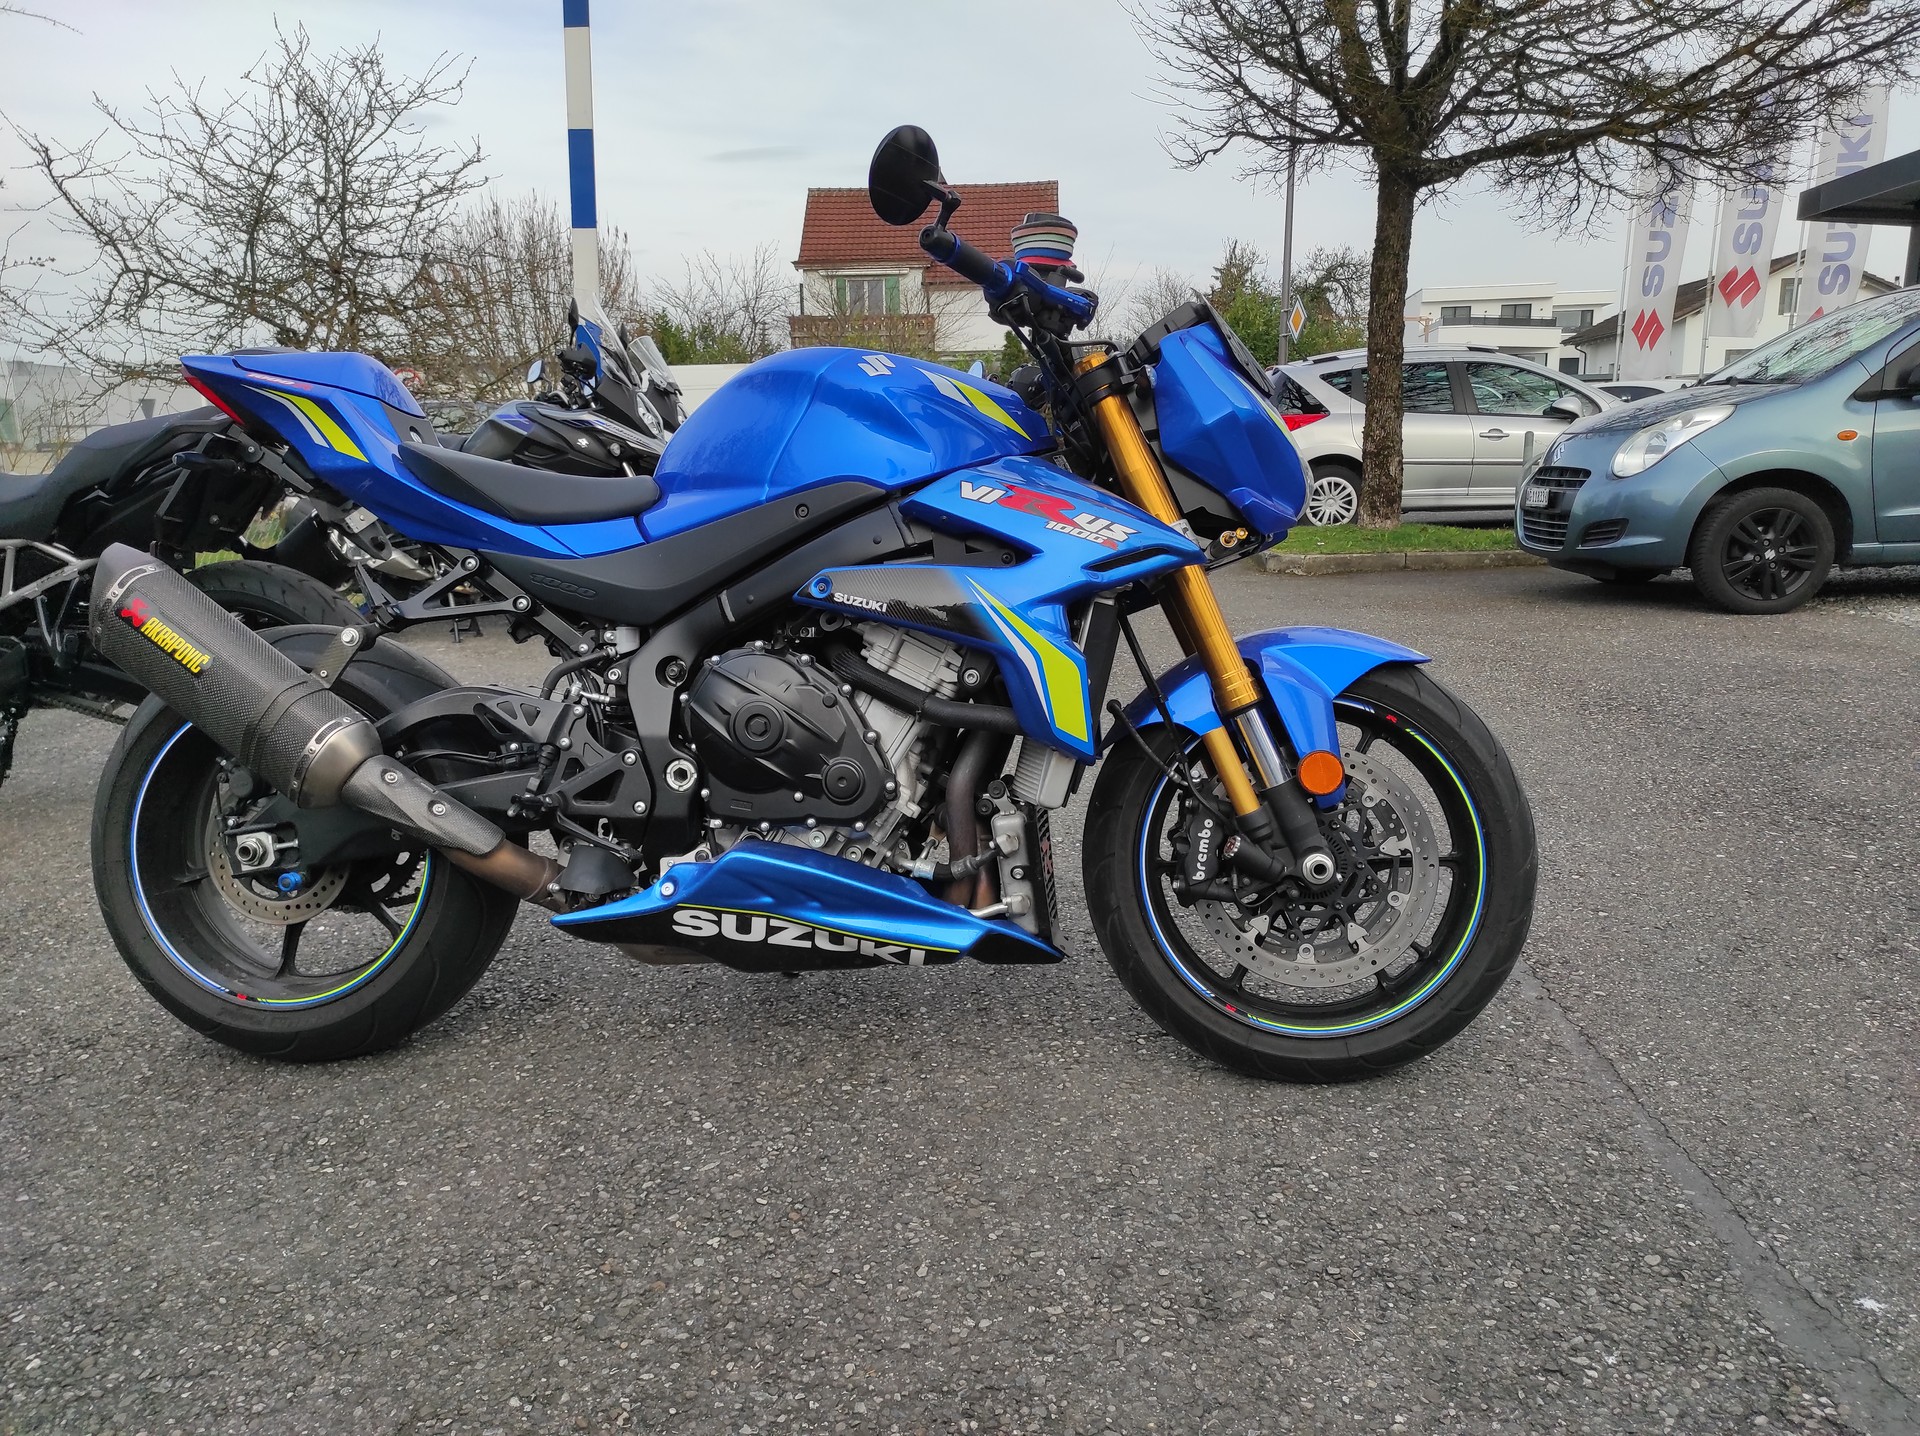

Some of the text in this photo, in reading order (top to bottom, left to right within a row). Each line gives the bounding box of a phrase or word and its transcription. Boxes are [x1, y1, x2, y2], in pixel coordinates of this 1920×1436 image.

[1817, 113, 1874, 296] SUKI
[833, 592, 888, 613] SUZUKI
[1192, 818, 1214, 881] brembo
[671, 909, 926, 966] SUZUKI
